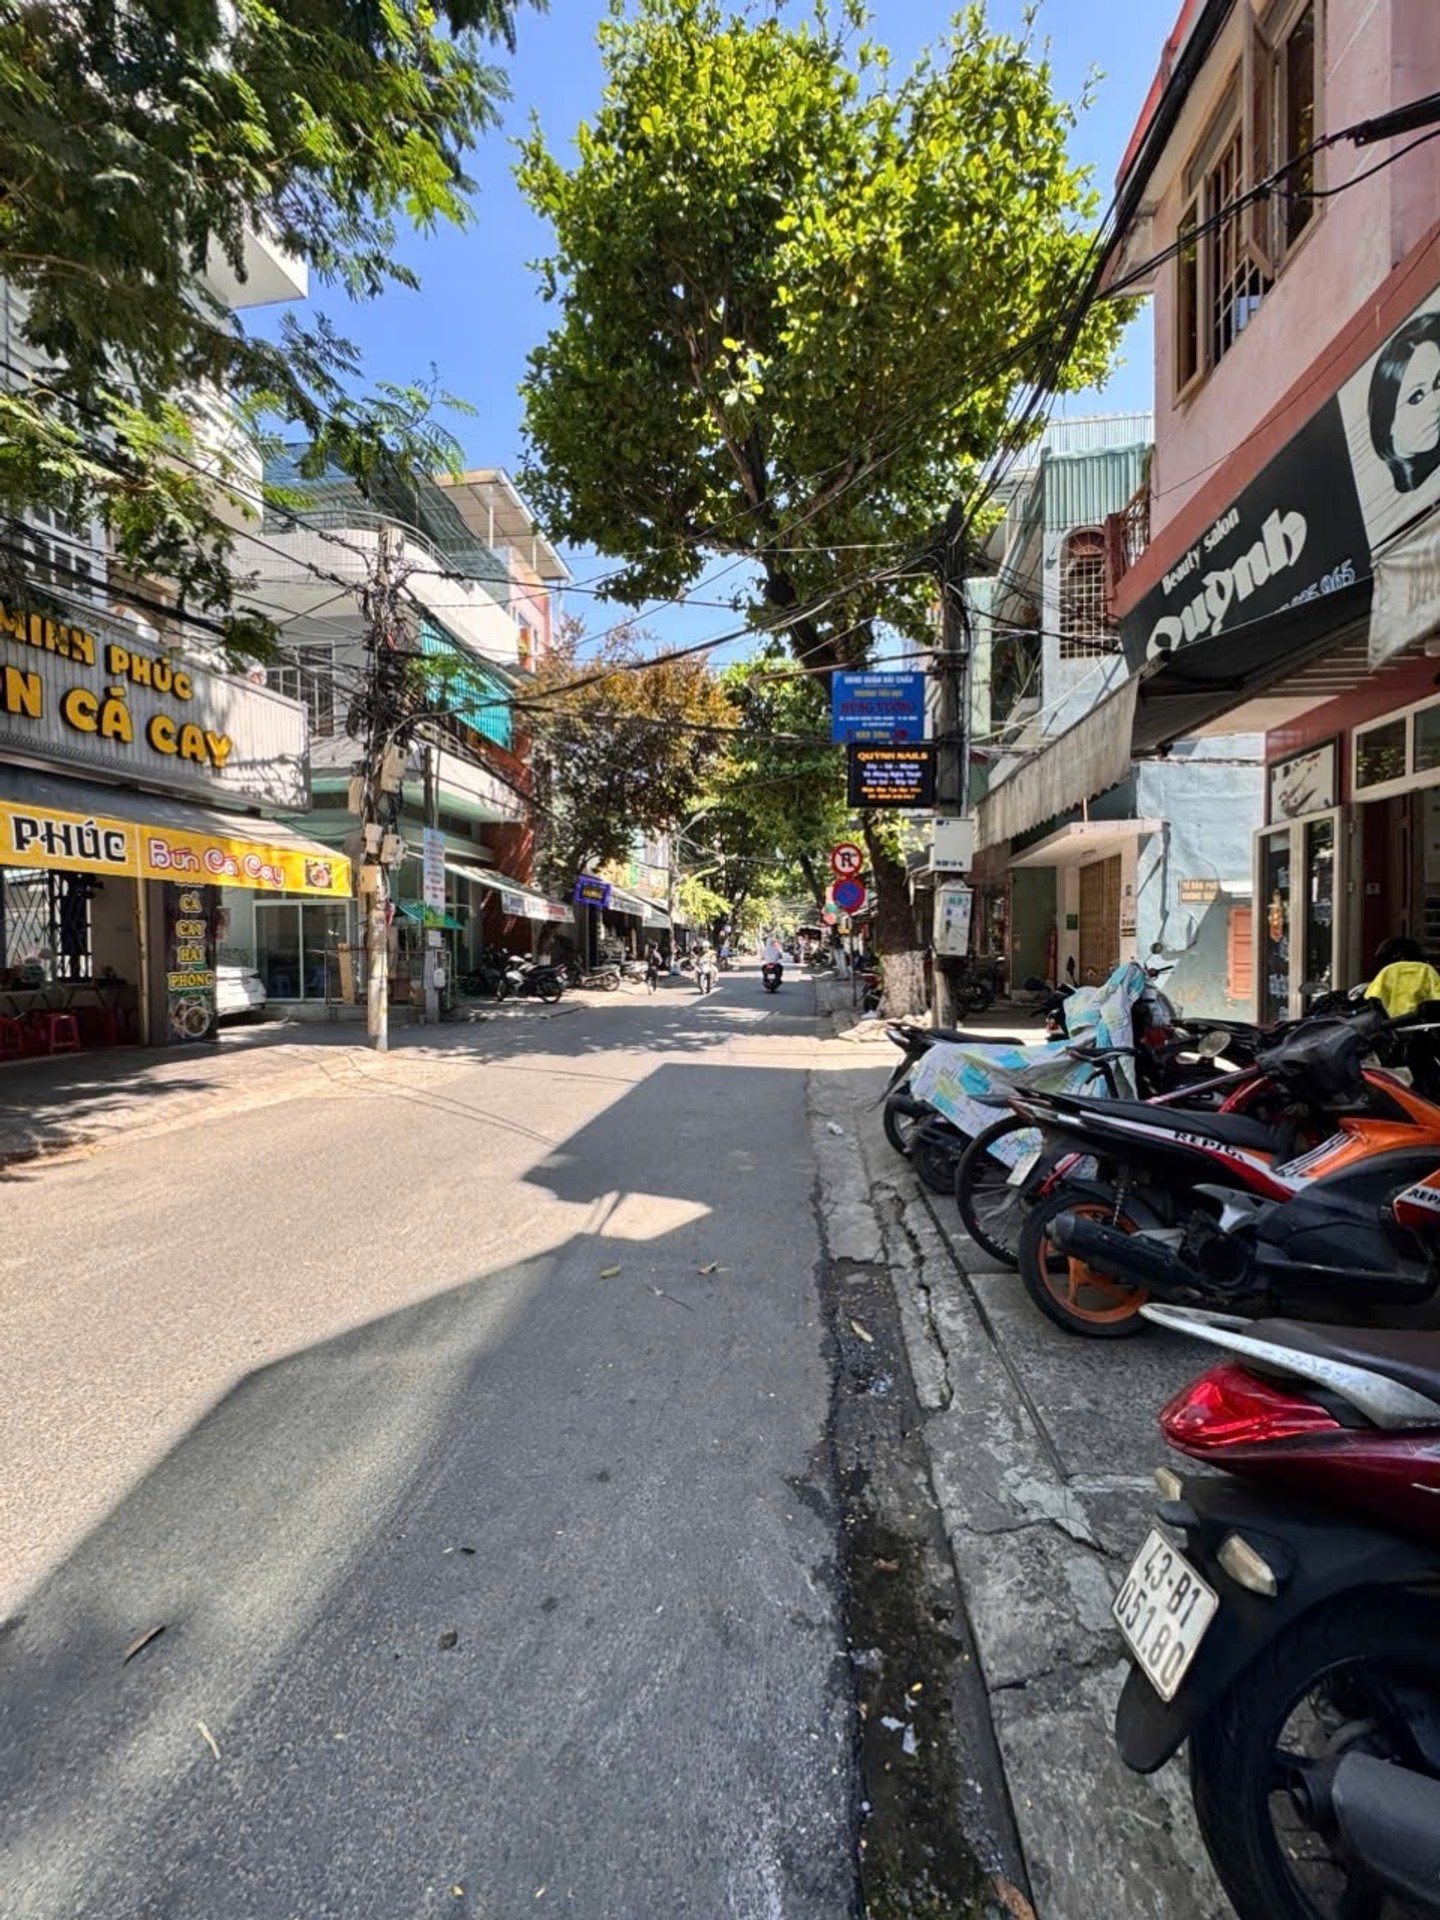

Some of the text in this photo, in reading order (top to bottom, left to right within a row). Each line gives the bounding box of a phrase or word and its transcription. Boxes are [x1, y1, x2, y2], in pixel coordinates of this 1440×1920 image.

[1161, 545, 1201, 596] Beauty
[108, 645, 193, 701] PHÚC
[148, 714, 233, 769] CAY
[896, 751, 929, 761] NAILS
[11, 815, 127, 863] PHÚC
[148, 838, 286, 888] Bún Cá Cay
[176, 919, 206, 938] CAY
[1408, 1187, 1440, 1205] REP
